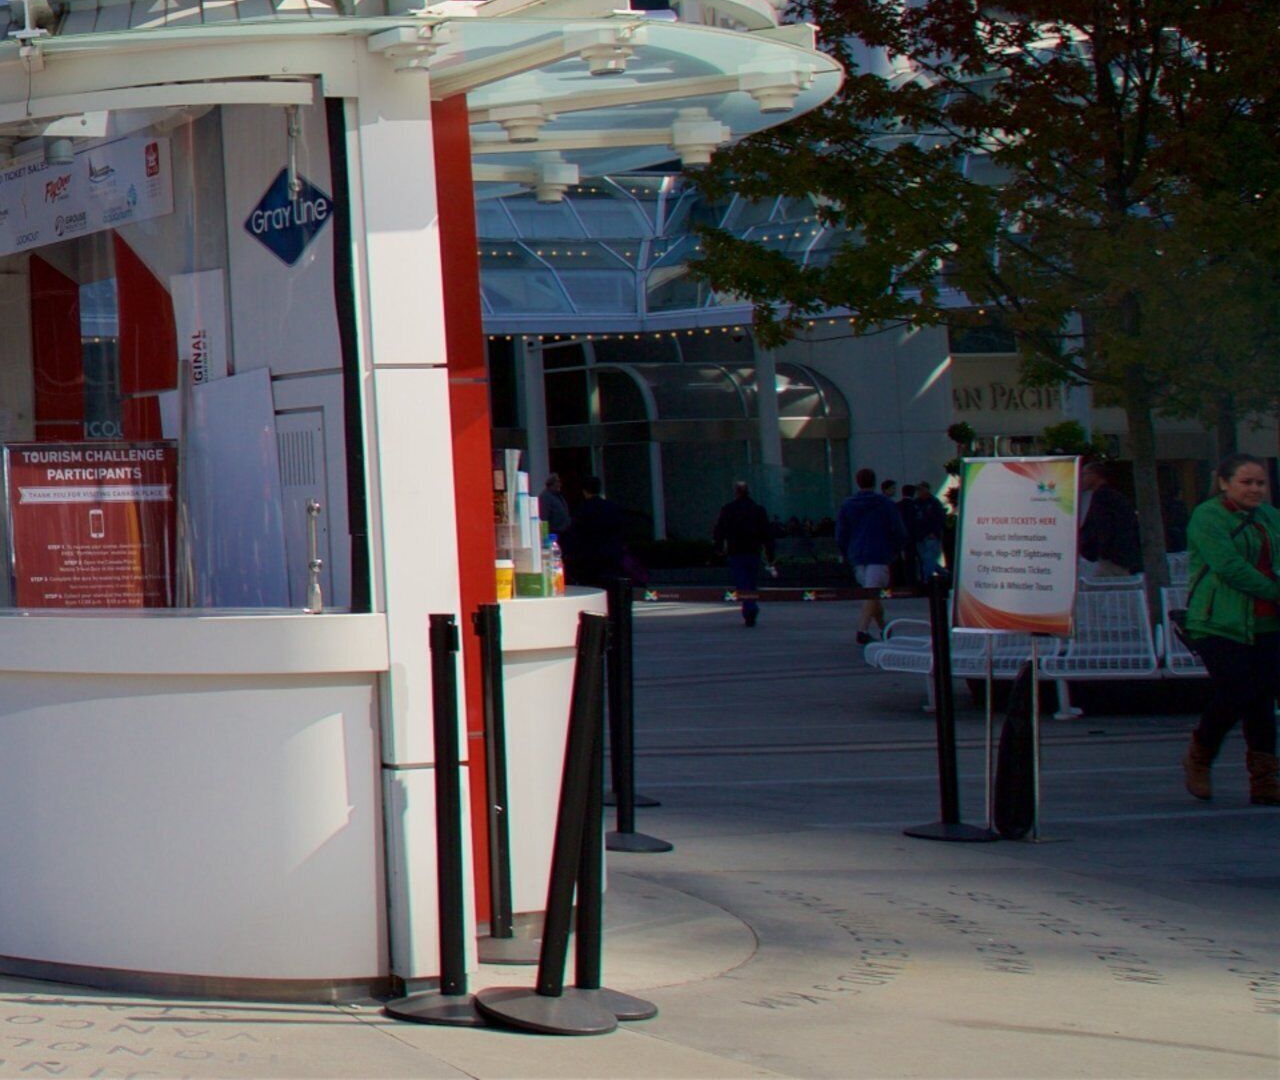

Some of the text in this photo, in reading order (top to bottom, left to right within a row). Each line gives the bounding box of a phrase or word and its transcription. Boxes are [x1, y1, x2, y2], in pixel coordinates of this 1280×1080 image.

[4, 167, 26, 184] TICKET
[22, 449, 165, 464] TOURISM CHALLENGE
[46, 467, 143, 481] PARTICIPANTS
[1010, 516, 1038, 525] TICKETS
[1007, 532, 1048, 541] Information
[977, 564, 990, 575] City
